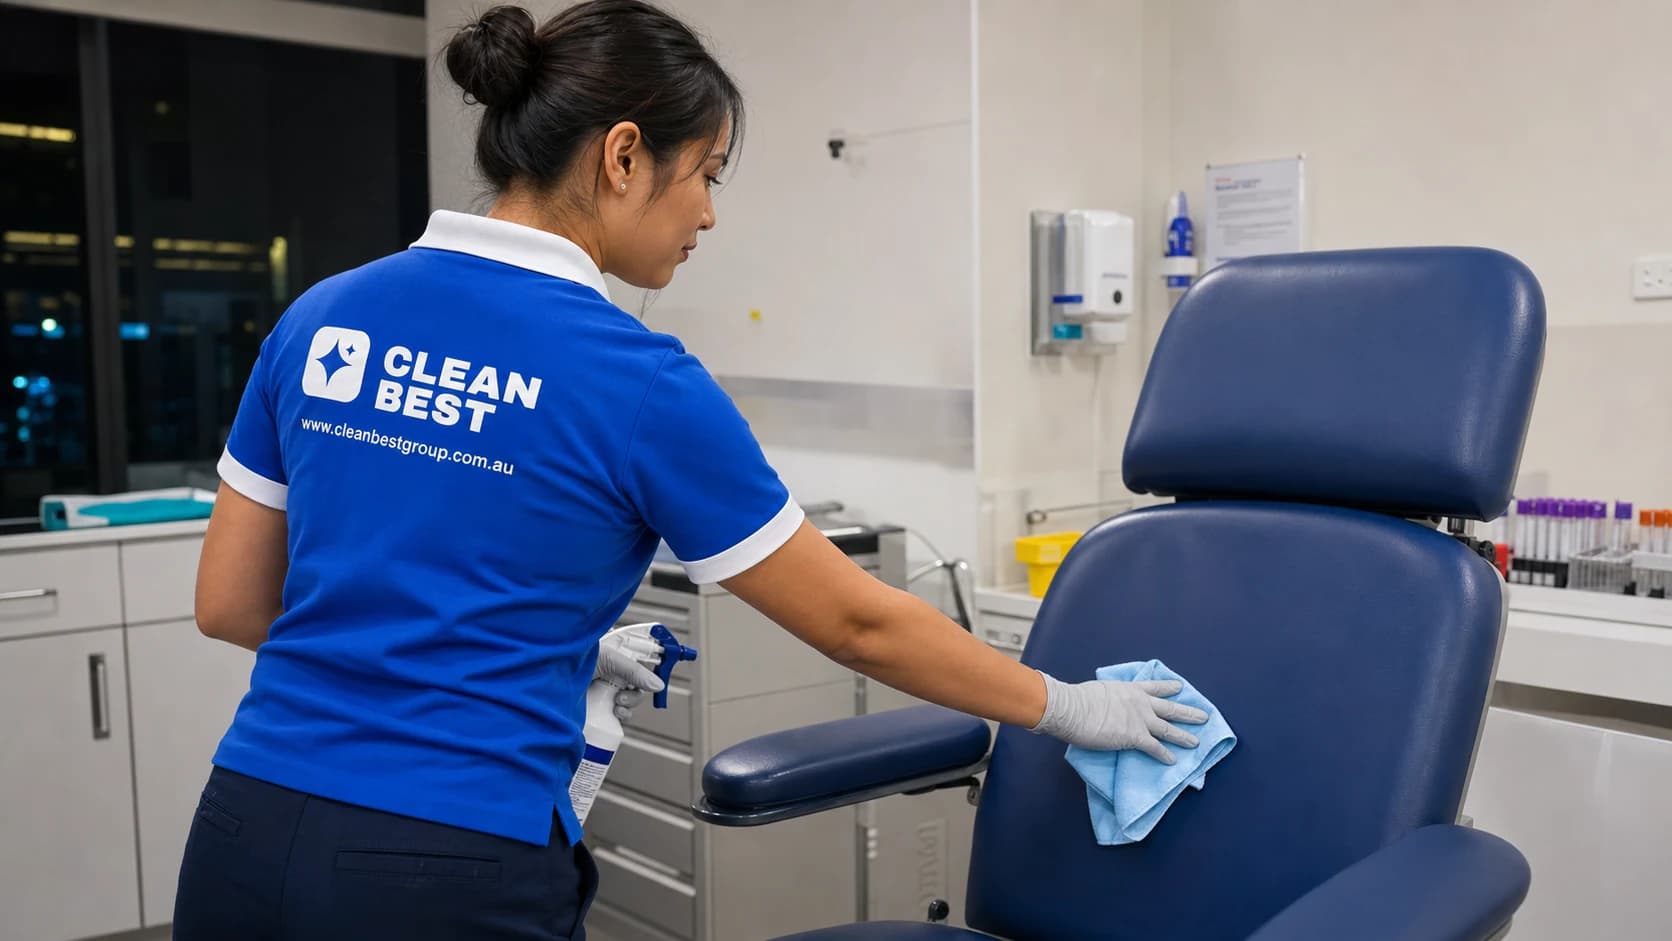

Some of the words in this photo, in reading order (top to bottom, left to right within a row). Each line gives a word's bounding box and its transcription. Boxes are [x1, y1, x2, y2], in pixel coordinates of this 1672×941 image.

[374, 378, 497, 433] BEST
[383, 345, 542, 410] CLEAN
[301, 417, 514, 476] www.cleanbestgroup.com.au
